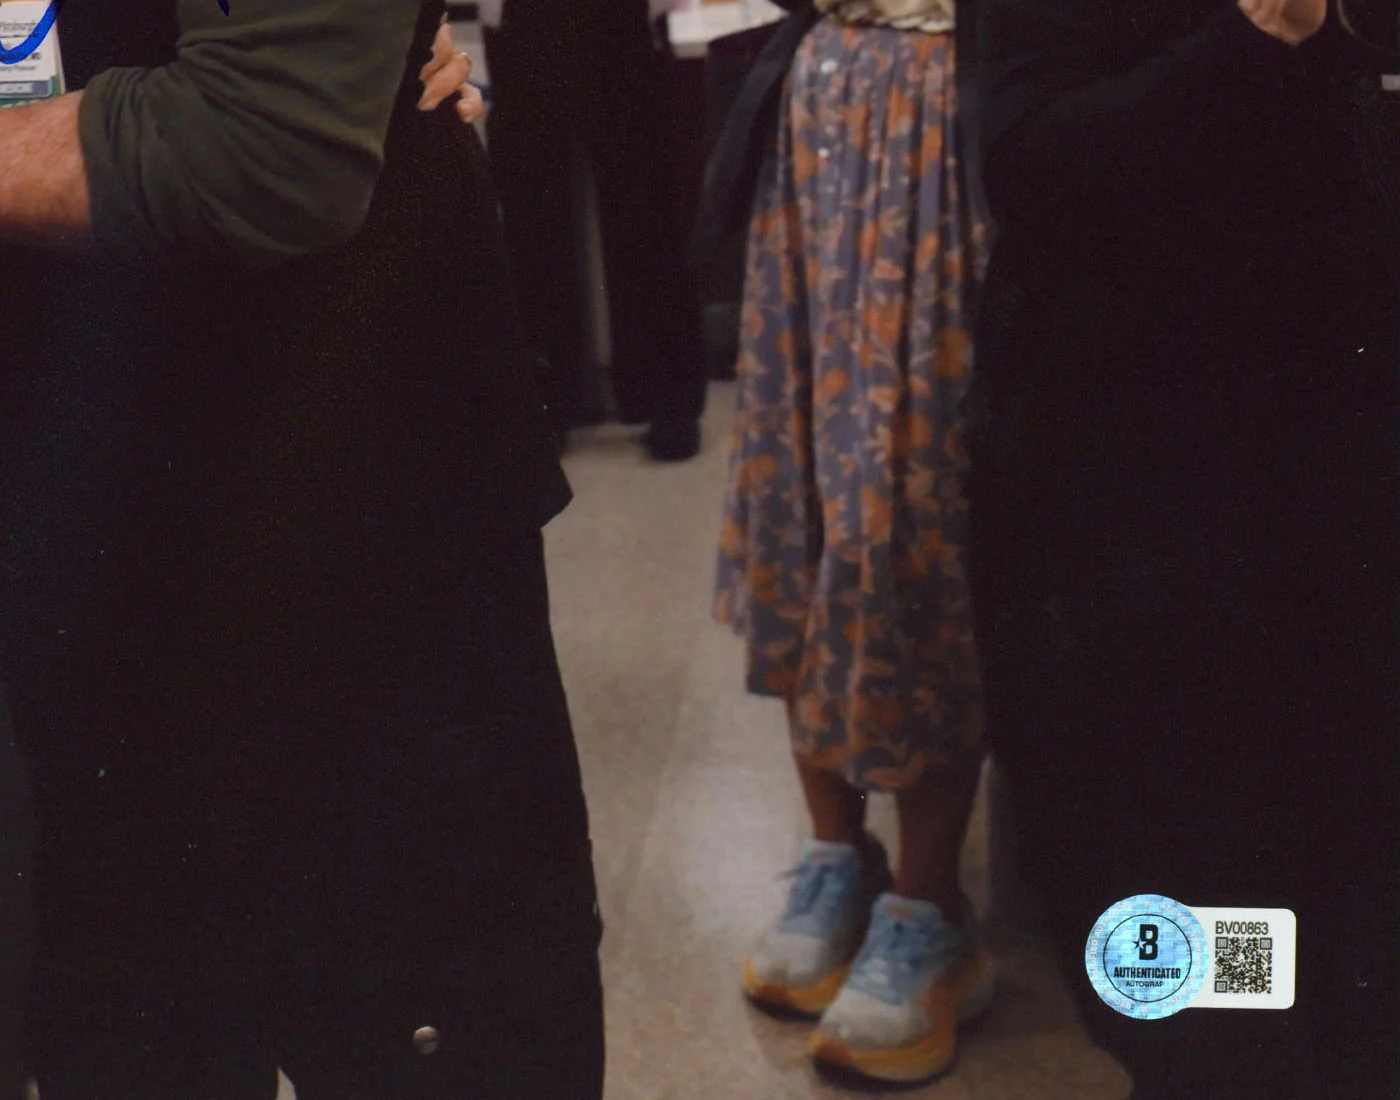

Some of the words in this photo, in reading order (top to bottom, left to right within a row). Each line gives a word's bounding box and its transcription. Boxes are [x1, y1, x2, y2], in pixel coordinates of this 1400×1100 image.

[1215, 920, 1269, 935] BV00863
[1113, 966, 1181, 979] AUTHENTICATED
[1125, 980, 1169, 988] AUTOGRAP
